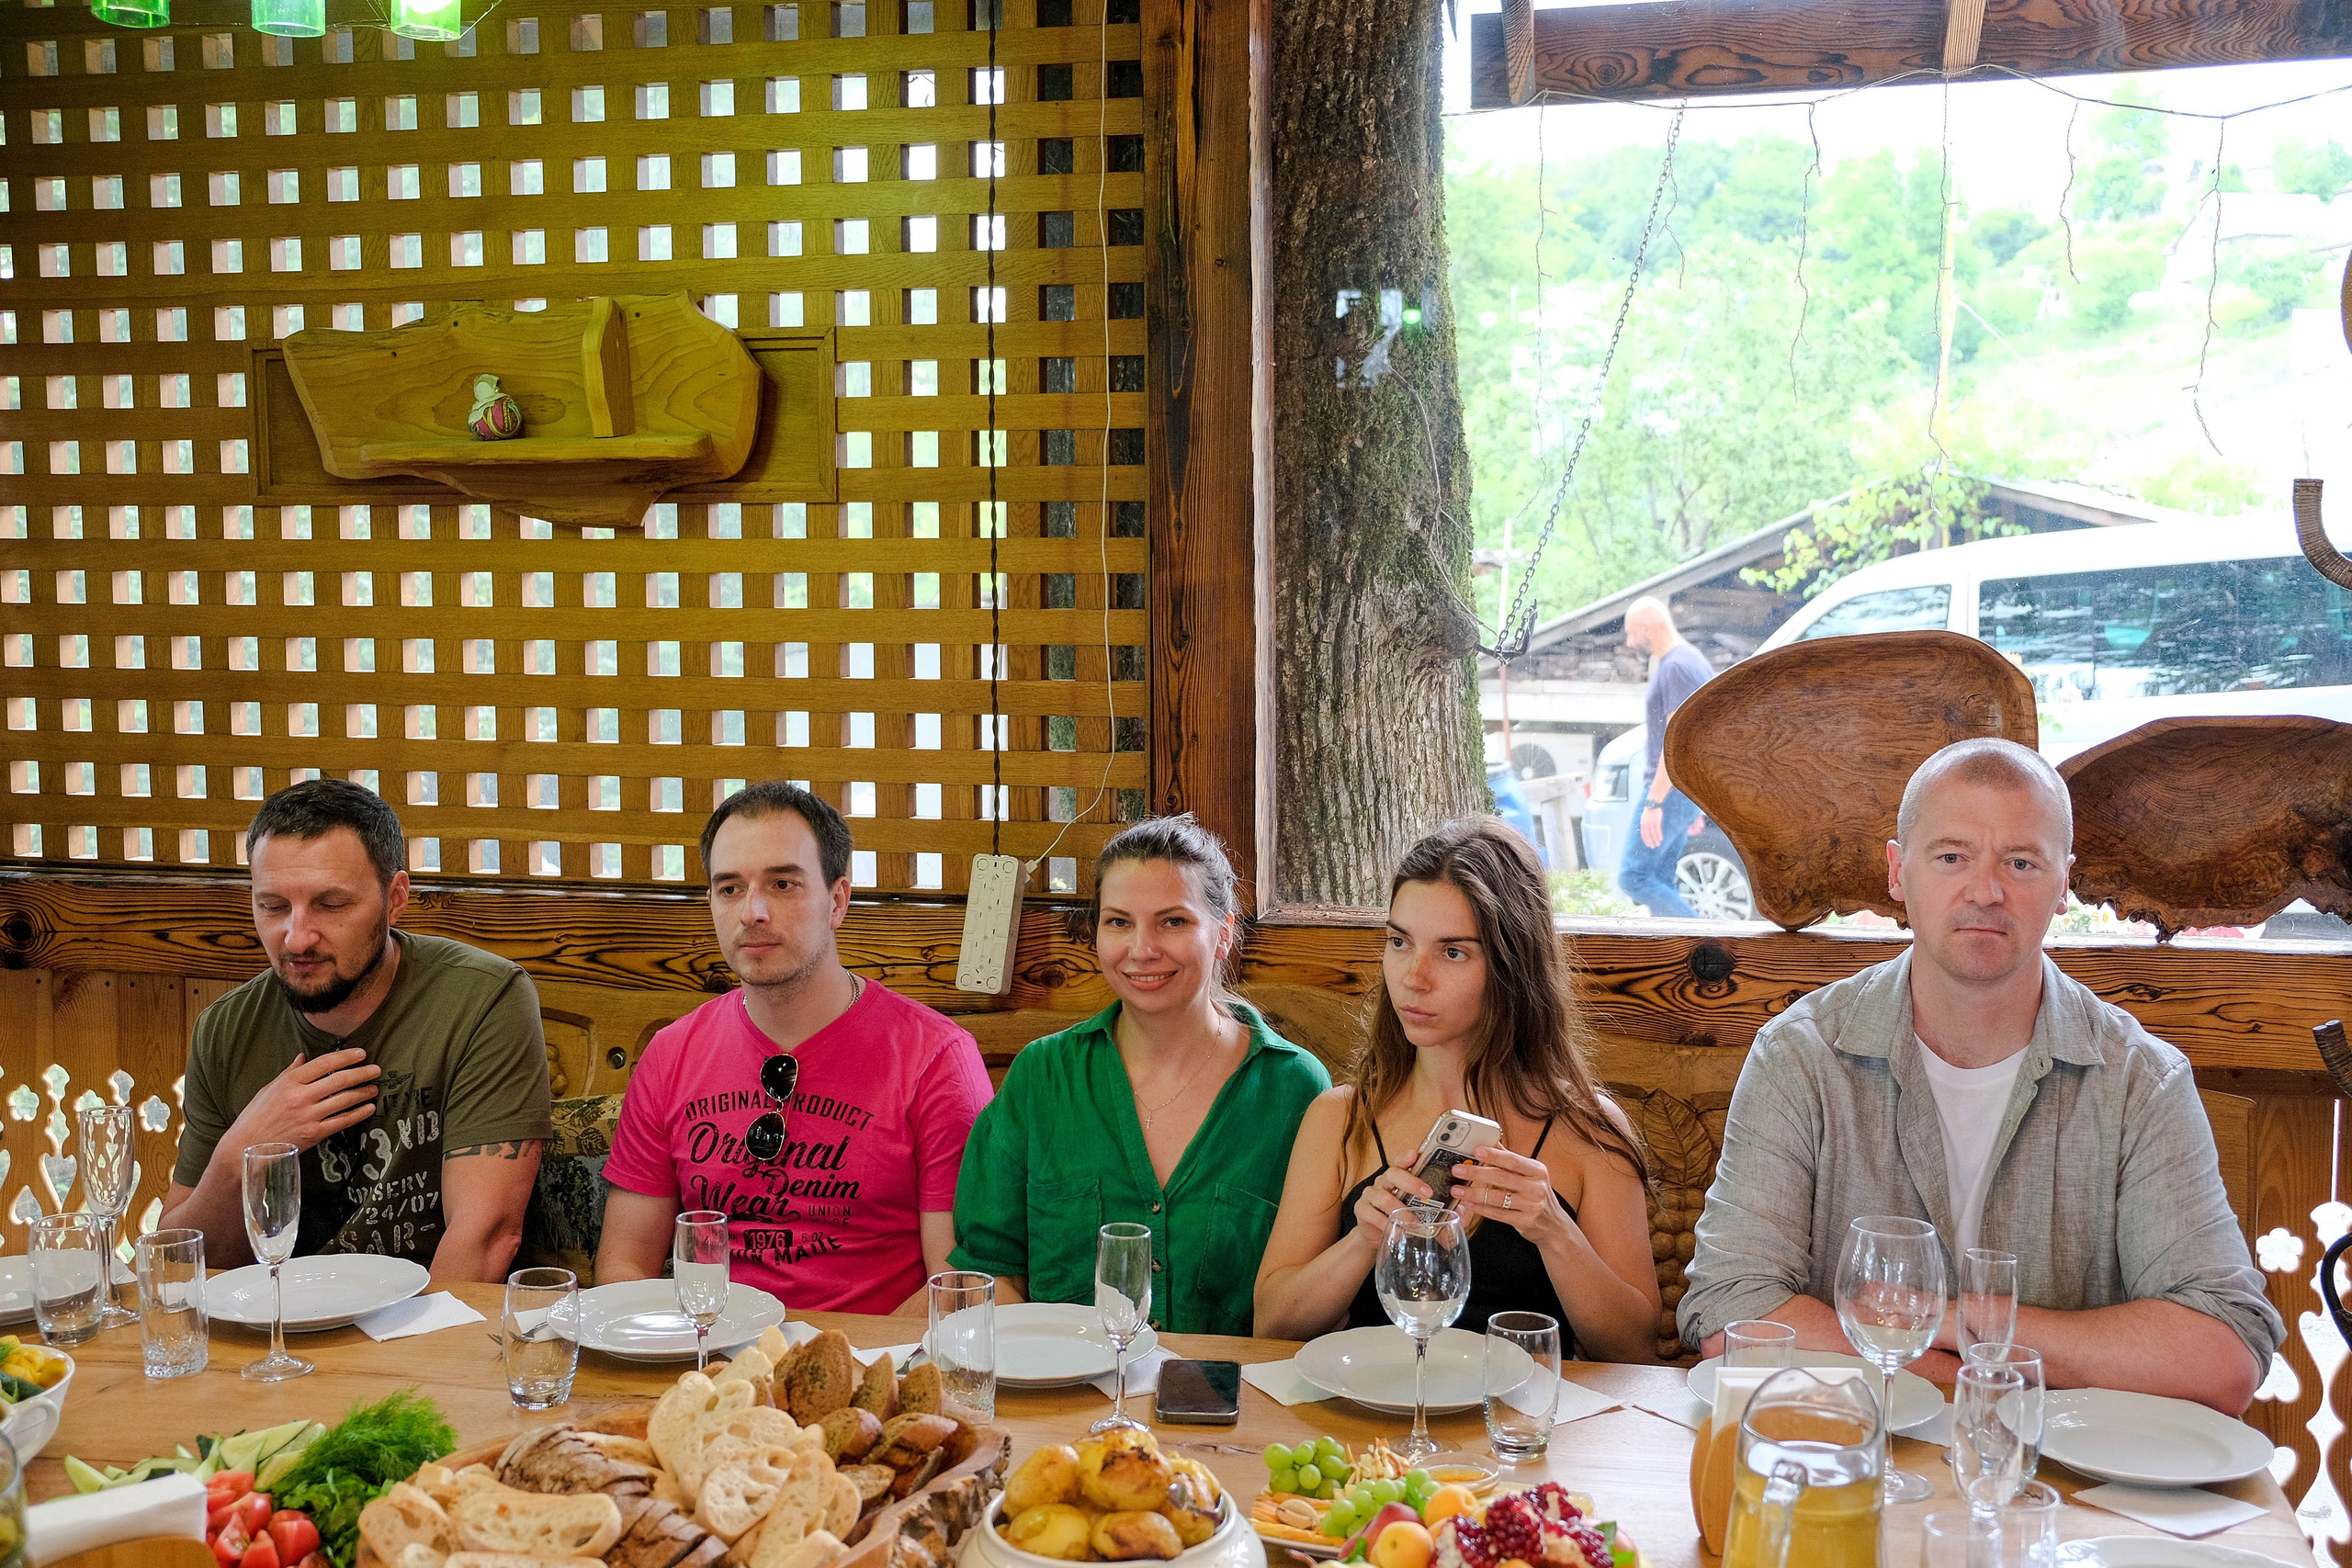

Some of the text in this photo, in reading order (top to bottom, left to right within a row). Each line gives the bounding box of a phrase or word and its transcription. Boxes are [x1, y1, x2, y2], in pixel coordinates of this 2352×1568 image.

[685, 1089, 875, 1131] ORIGINAL RODUCT
[690, 1175, 802, 1224] Wear
[758, 1168, 862, 1201] Denim
[808, 1204, 851, 1217] UNION
[750, 1231, 786, 1250] 1976
